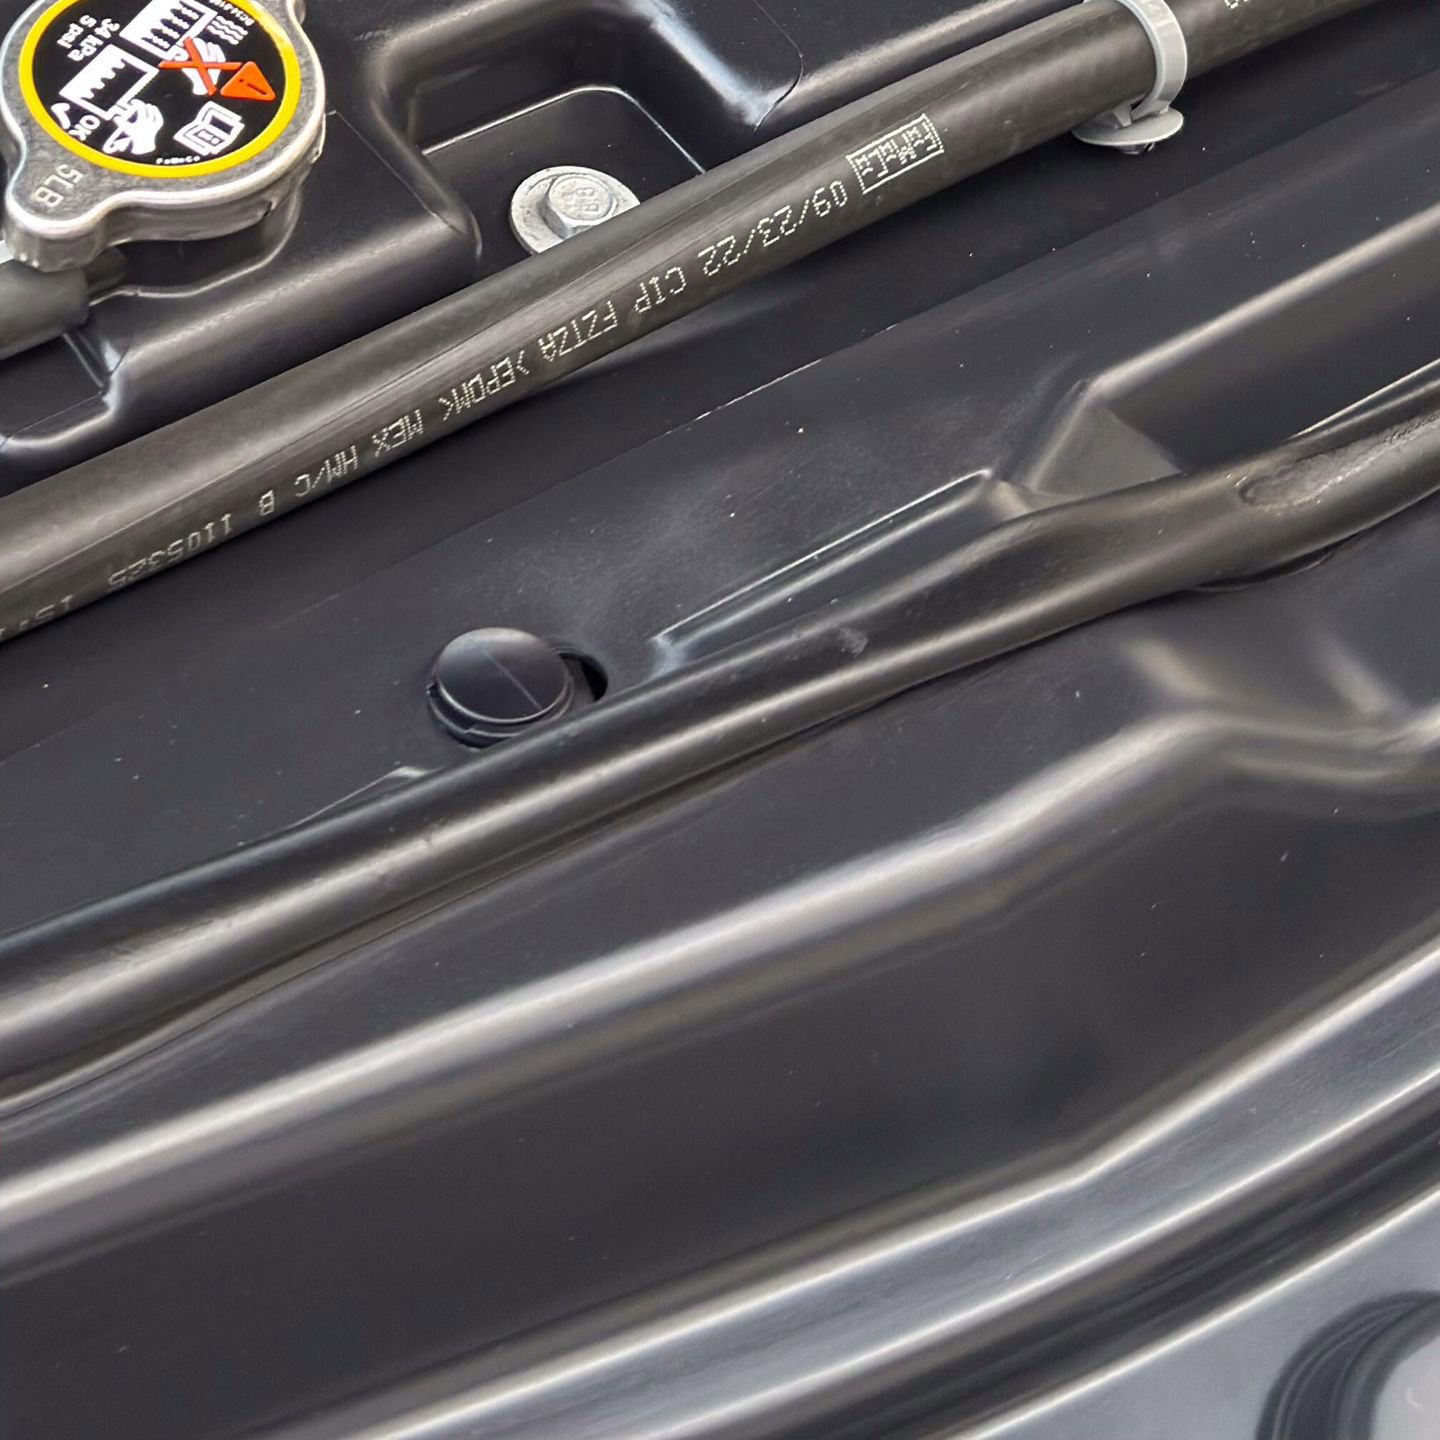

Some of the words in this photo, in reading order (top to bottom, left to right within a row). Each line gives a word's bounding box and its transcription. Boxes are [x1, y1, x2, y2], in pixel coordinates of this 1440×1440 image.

[56, 21, 83, 49] psi
[66, 33, 103, 62] kPa
[93, 17, 120, 39] 34
[68, 116, 100, 141] OK
[35, 163, 82, 209] 5LB
[691, 178, 854, 277] 09/23/22
[625, 263, 688, 313] CIP
[534, 301, 622, 361] FZTZA
[429, 347, 536, 420] >EPDM<
[365, 407, 429, 457] MEX
[287, 445, 364, 497] HM/C
[254, 489, 279, 516] B
[101, 512, 238, 591] 1105325
